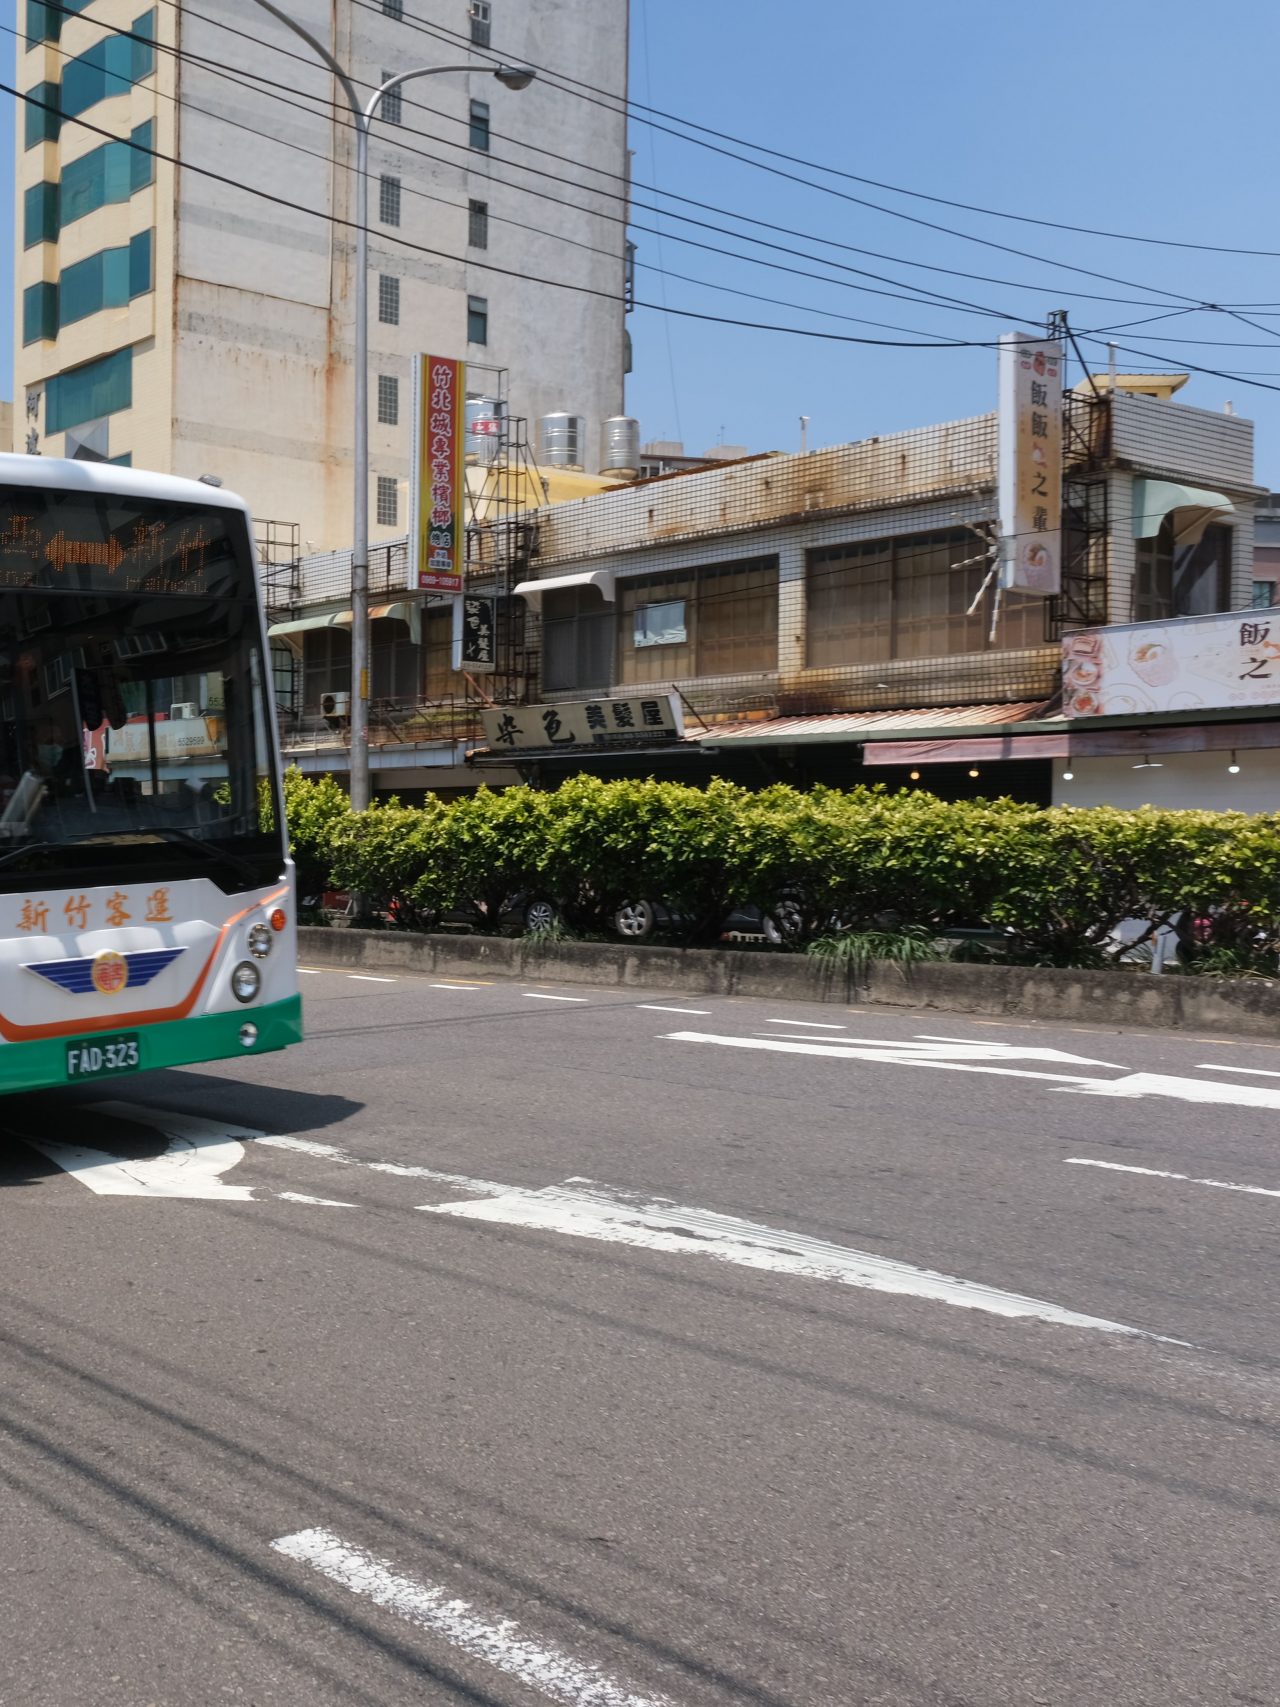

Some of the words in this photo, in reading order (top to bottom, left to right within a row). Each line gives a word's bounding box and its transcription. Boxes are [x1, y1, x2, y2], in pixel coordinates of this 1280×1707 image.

[430, 364, 453, 527] 竹北城專業檳榔
[16, 887, 174, 933] 新竹客運
[67, 1042, 139, 1075] FAD-323
